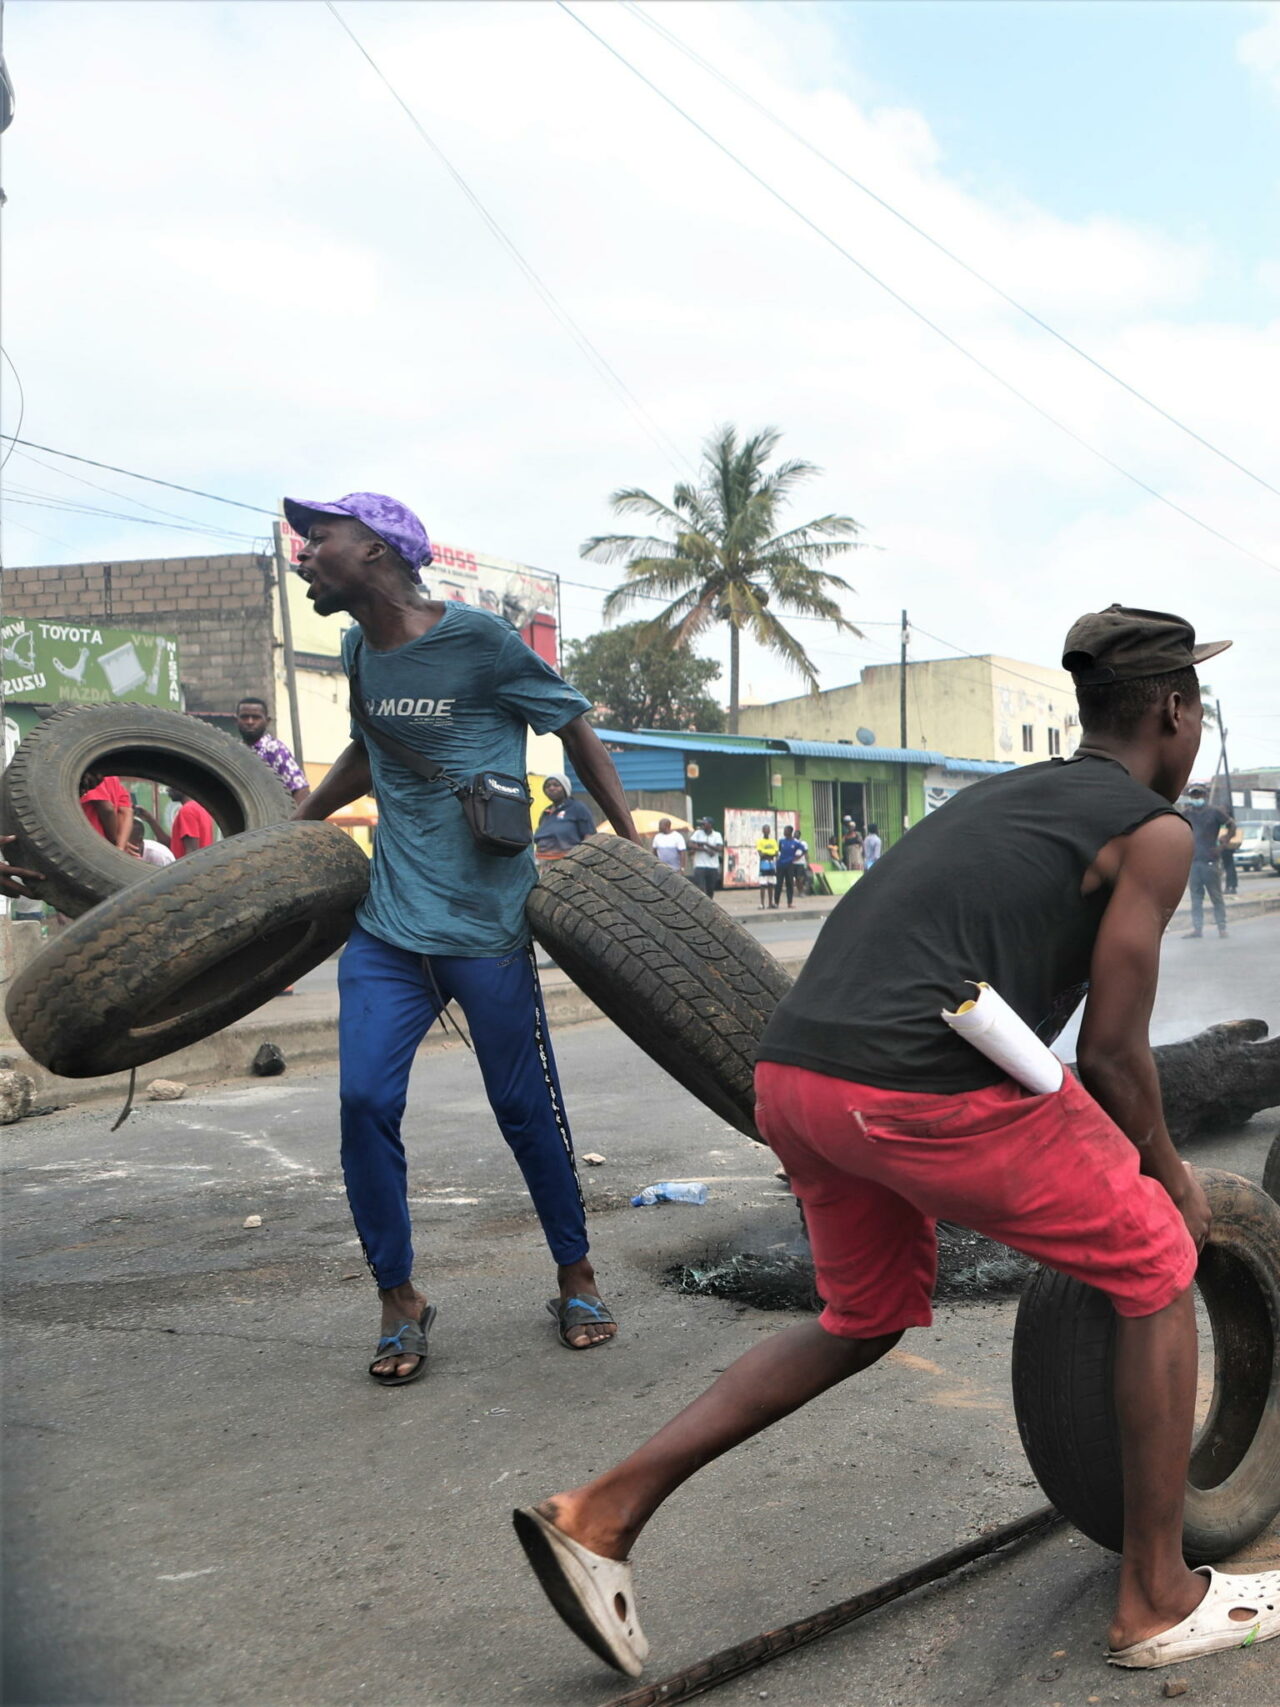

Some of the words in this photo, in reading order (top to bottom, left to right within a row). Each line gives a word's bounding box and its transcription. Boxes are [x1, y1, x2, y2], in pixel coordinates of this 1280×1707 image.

[1, 620, 25, 640] MW
[38, 623, 103, 645] TOYOTA
[131, 634, 155, 647] VW
[166, 641, 179, 701] NISSAN
[59, 686, 111, 701] MAZDA
[376, 698, 456, 716] MODE
